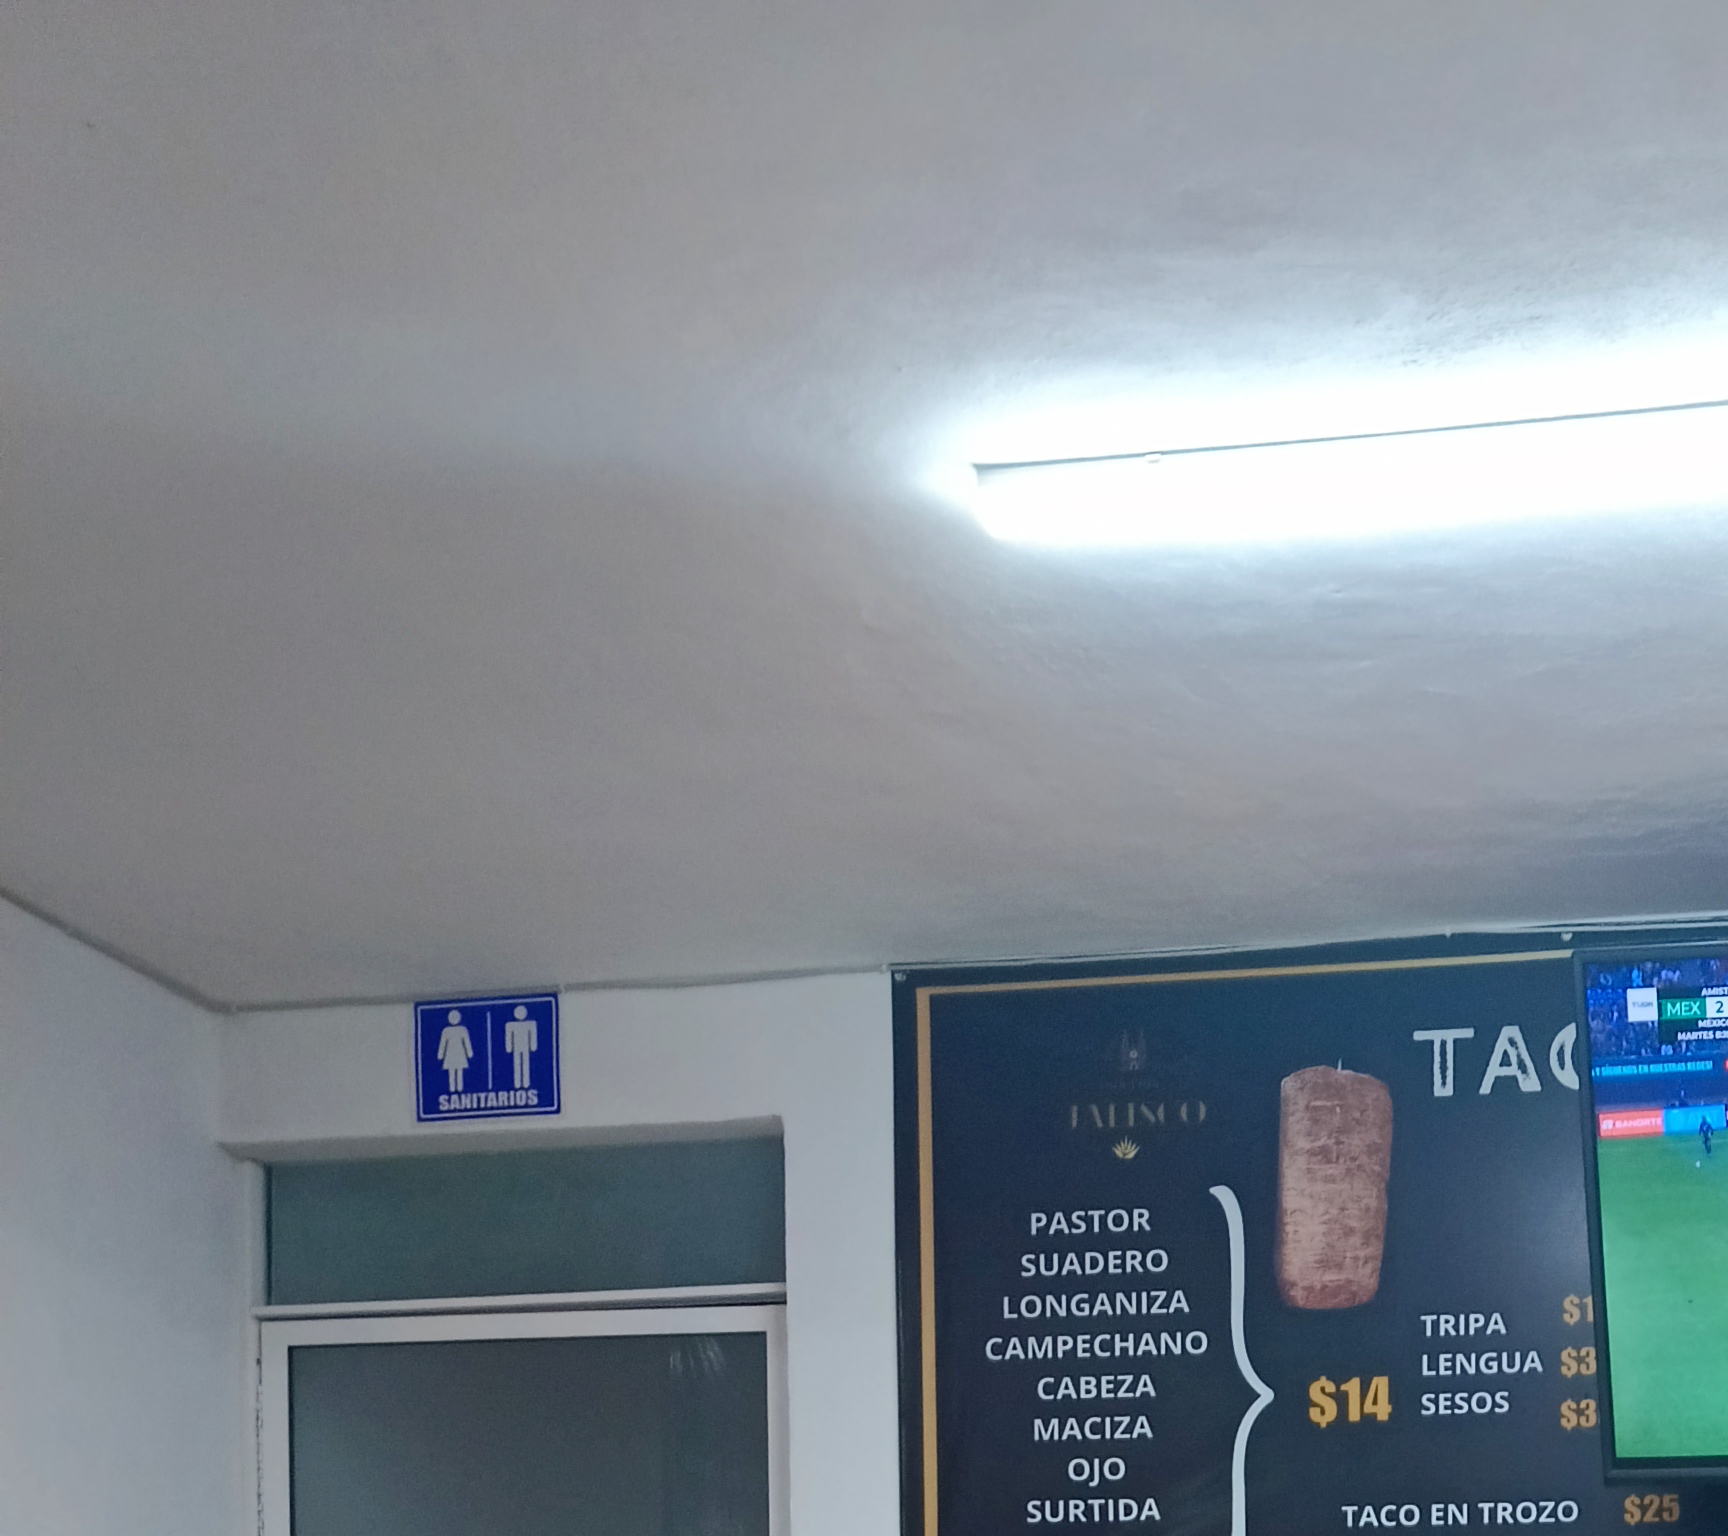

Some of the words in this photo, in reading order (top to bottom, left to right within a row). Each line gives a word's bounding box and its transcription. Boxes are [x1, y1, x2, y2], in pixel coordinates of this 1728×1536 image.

[1666, 1000, 1701, 1016] MEX
[1715, 1001, 1724, 1013] 2
[1677, 1030, 1714, 1041] MARTES
[438, 1089, 538, 1111] SANITARIOS
[1029, 1207, 1152, 1237] PASTOR
[1019, 1247, 1170, 1279] SUADERO
[1001, 1289, 1190, 1320] LONGANIZA
[1420, 1312, 1508, 1337] TRIPA
[984, 1328, 1209, 1362] CAMPECHANO
[1420, 1350, 1544, 1377] LENGUA
[1036, 1373, 1157, 1401] CABEZA
[1307, 1374, 1393, 1429] $14
[1419, 1390, 1510, 1417] SESOS
[1032, 1415, 1155, 1442] MACIZA
[1067, 1455, 1127, 1486] OJO
[1025, 1496, 1162, 1524] SURTIDA
[1341, 1502, 1422, 1529] TACO
[1429, 1502, 1469, 1527] EN
[1478, 1499, 1581, 1526] TROZO
[1623, 1492, 1681, 1528] $25
